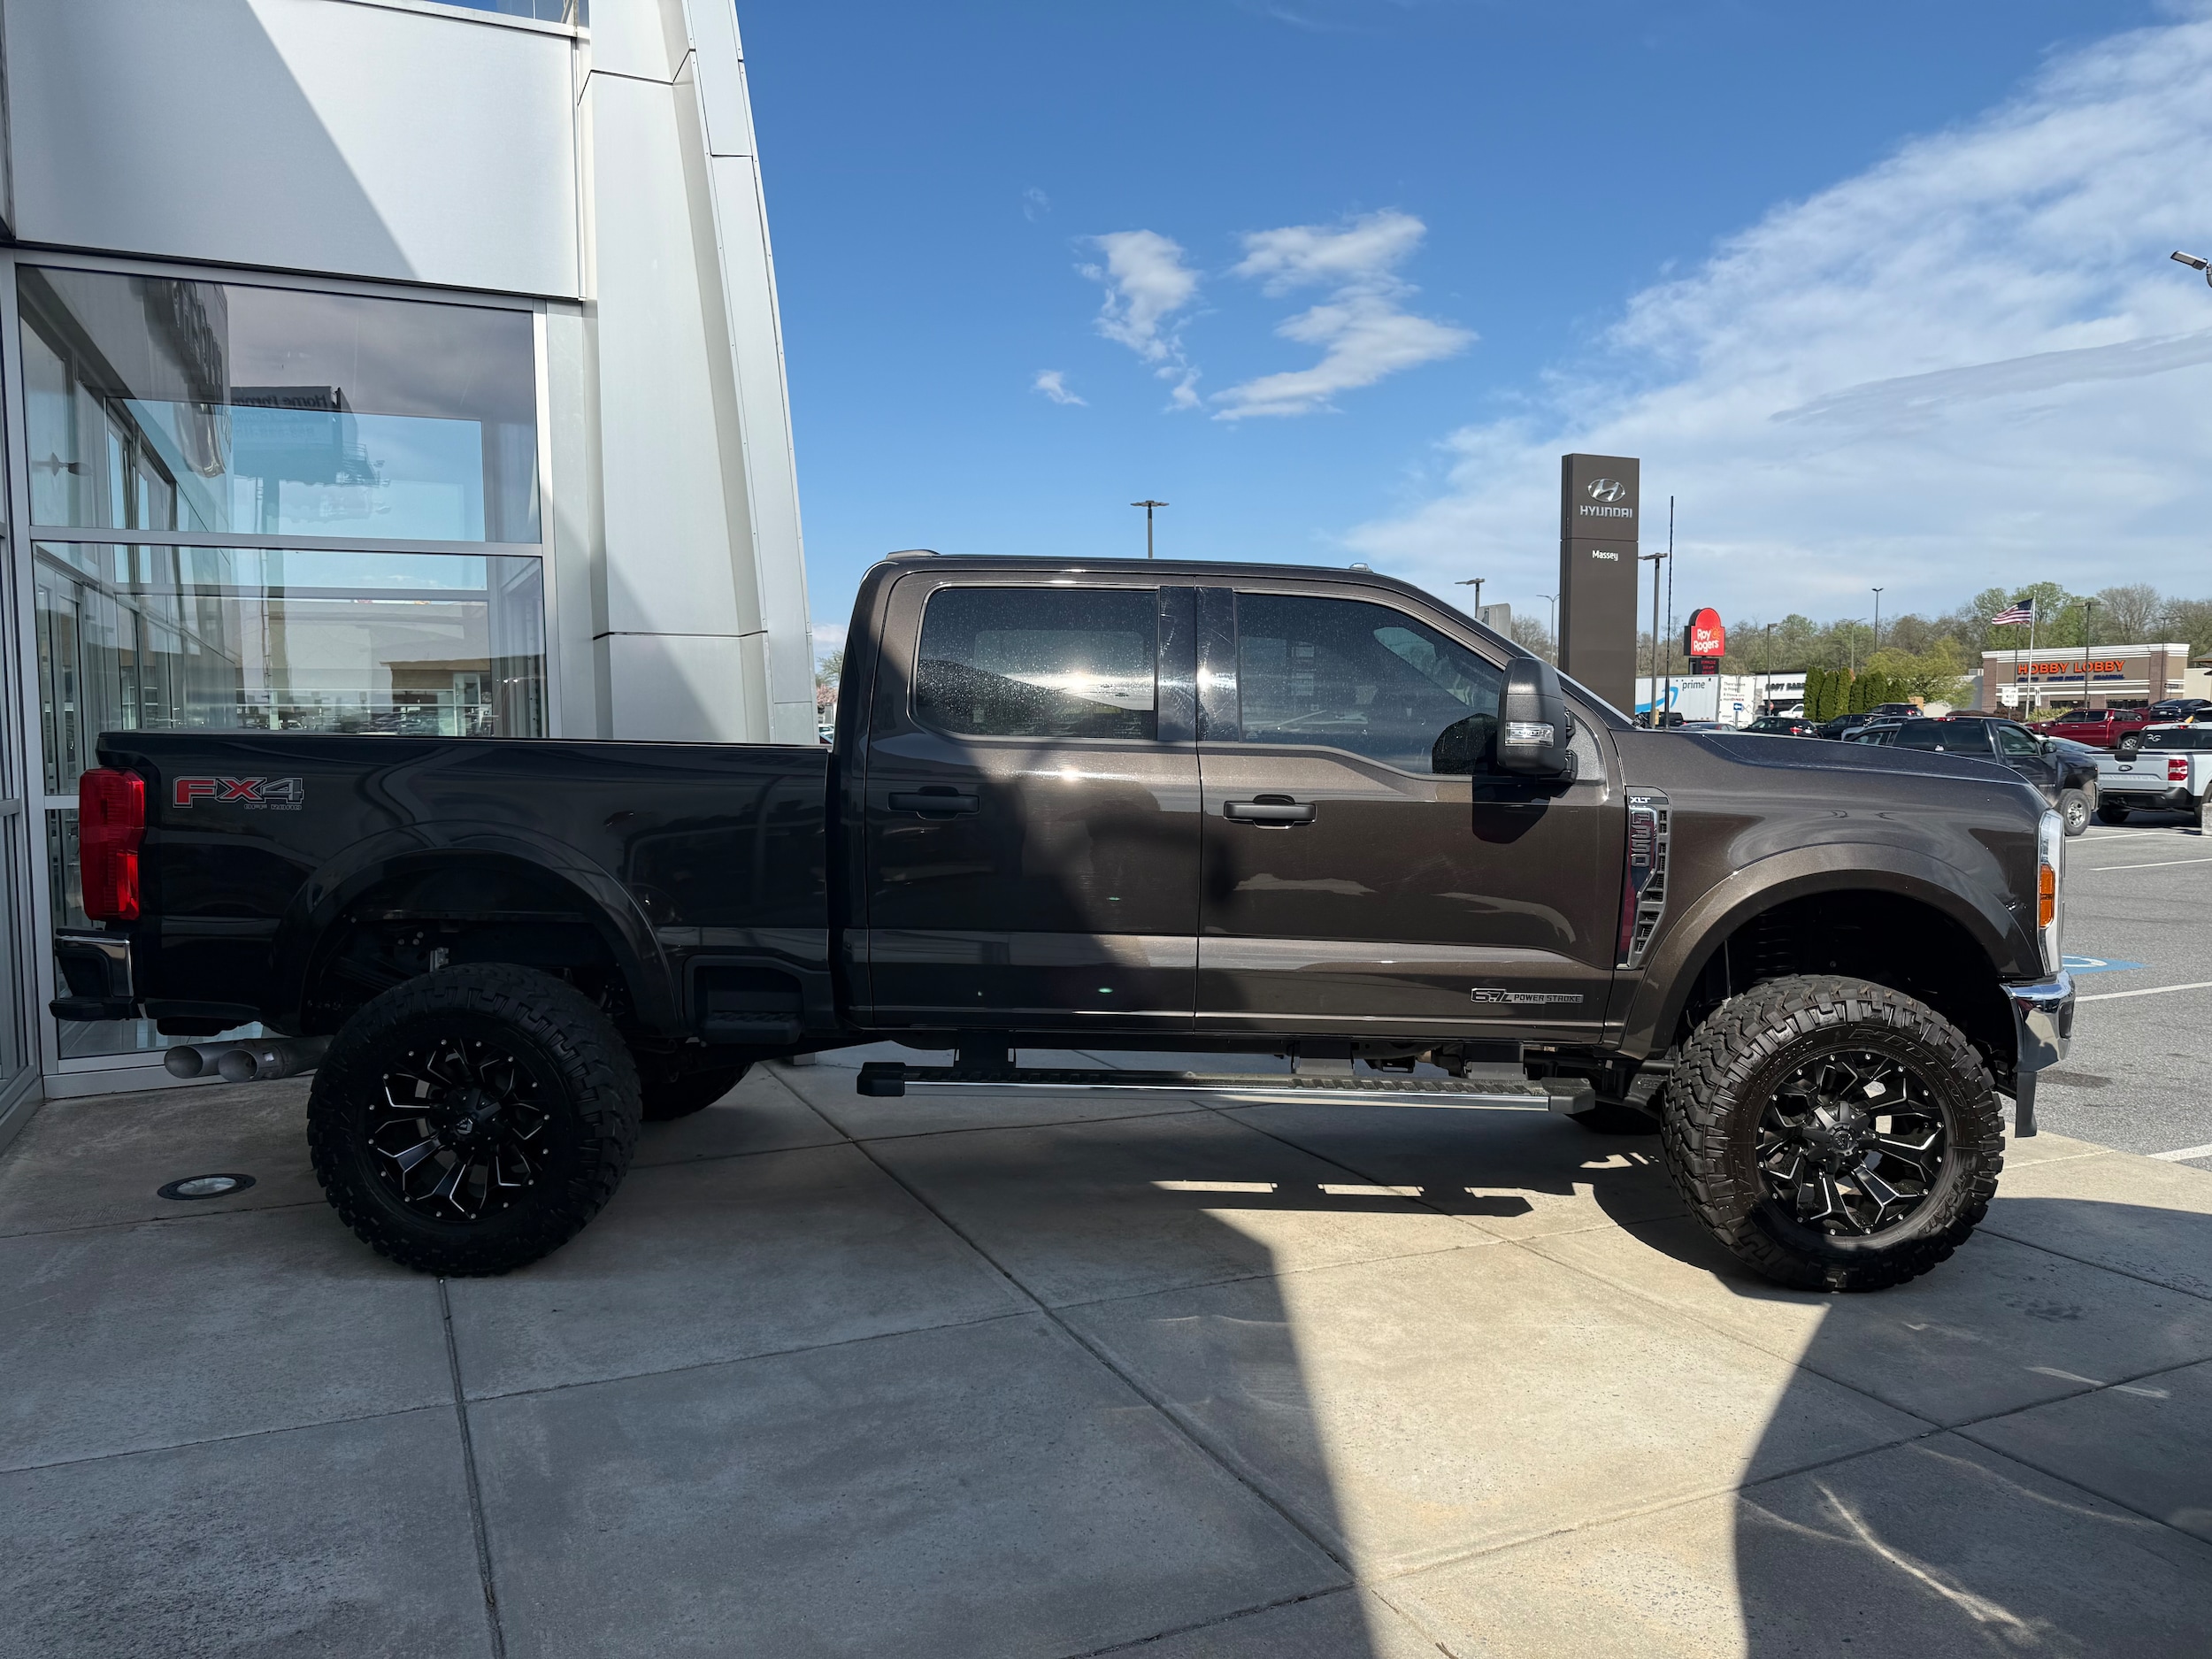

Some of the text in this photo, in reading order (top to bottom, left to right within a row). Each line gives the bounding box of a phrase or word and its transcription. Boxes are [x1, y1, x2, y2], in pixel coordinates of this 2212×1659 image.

[1579, 505, 1632, 518] HYUNDAI
[1592, 550, 1618, 561] Massey
[1697, 628, 1711, 641] Roy
[1694, 640, 1719, 653] Rogers
[2017, 660, 2125, 674] HOBBY LOBBY
[1682, 680, 1706, 691] prime
[173, 776, 304, 808] FX4
[1471, 988, 1512, 1002] 6.7L
[1848, 1029, 1967, 1108] NITTO
